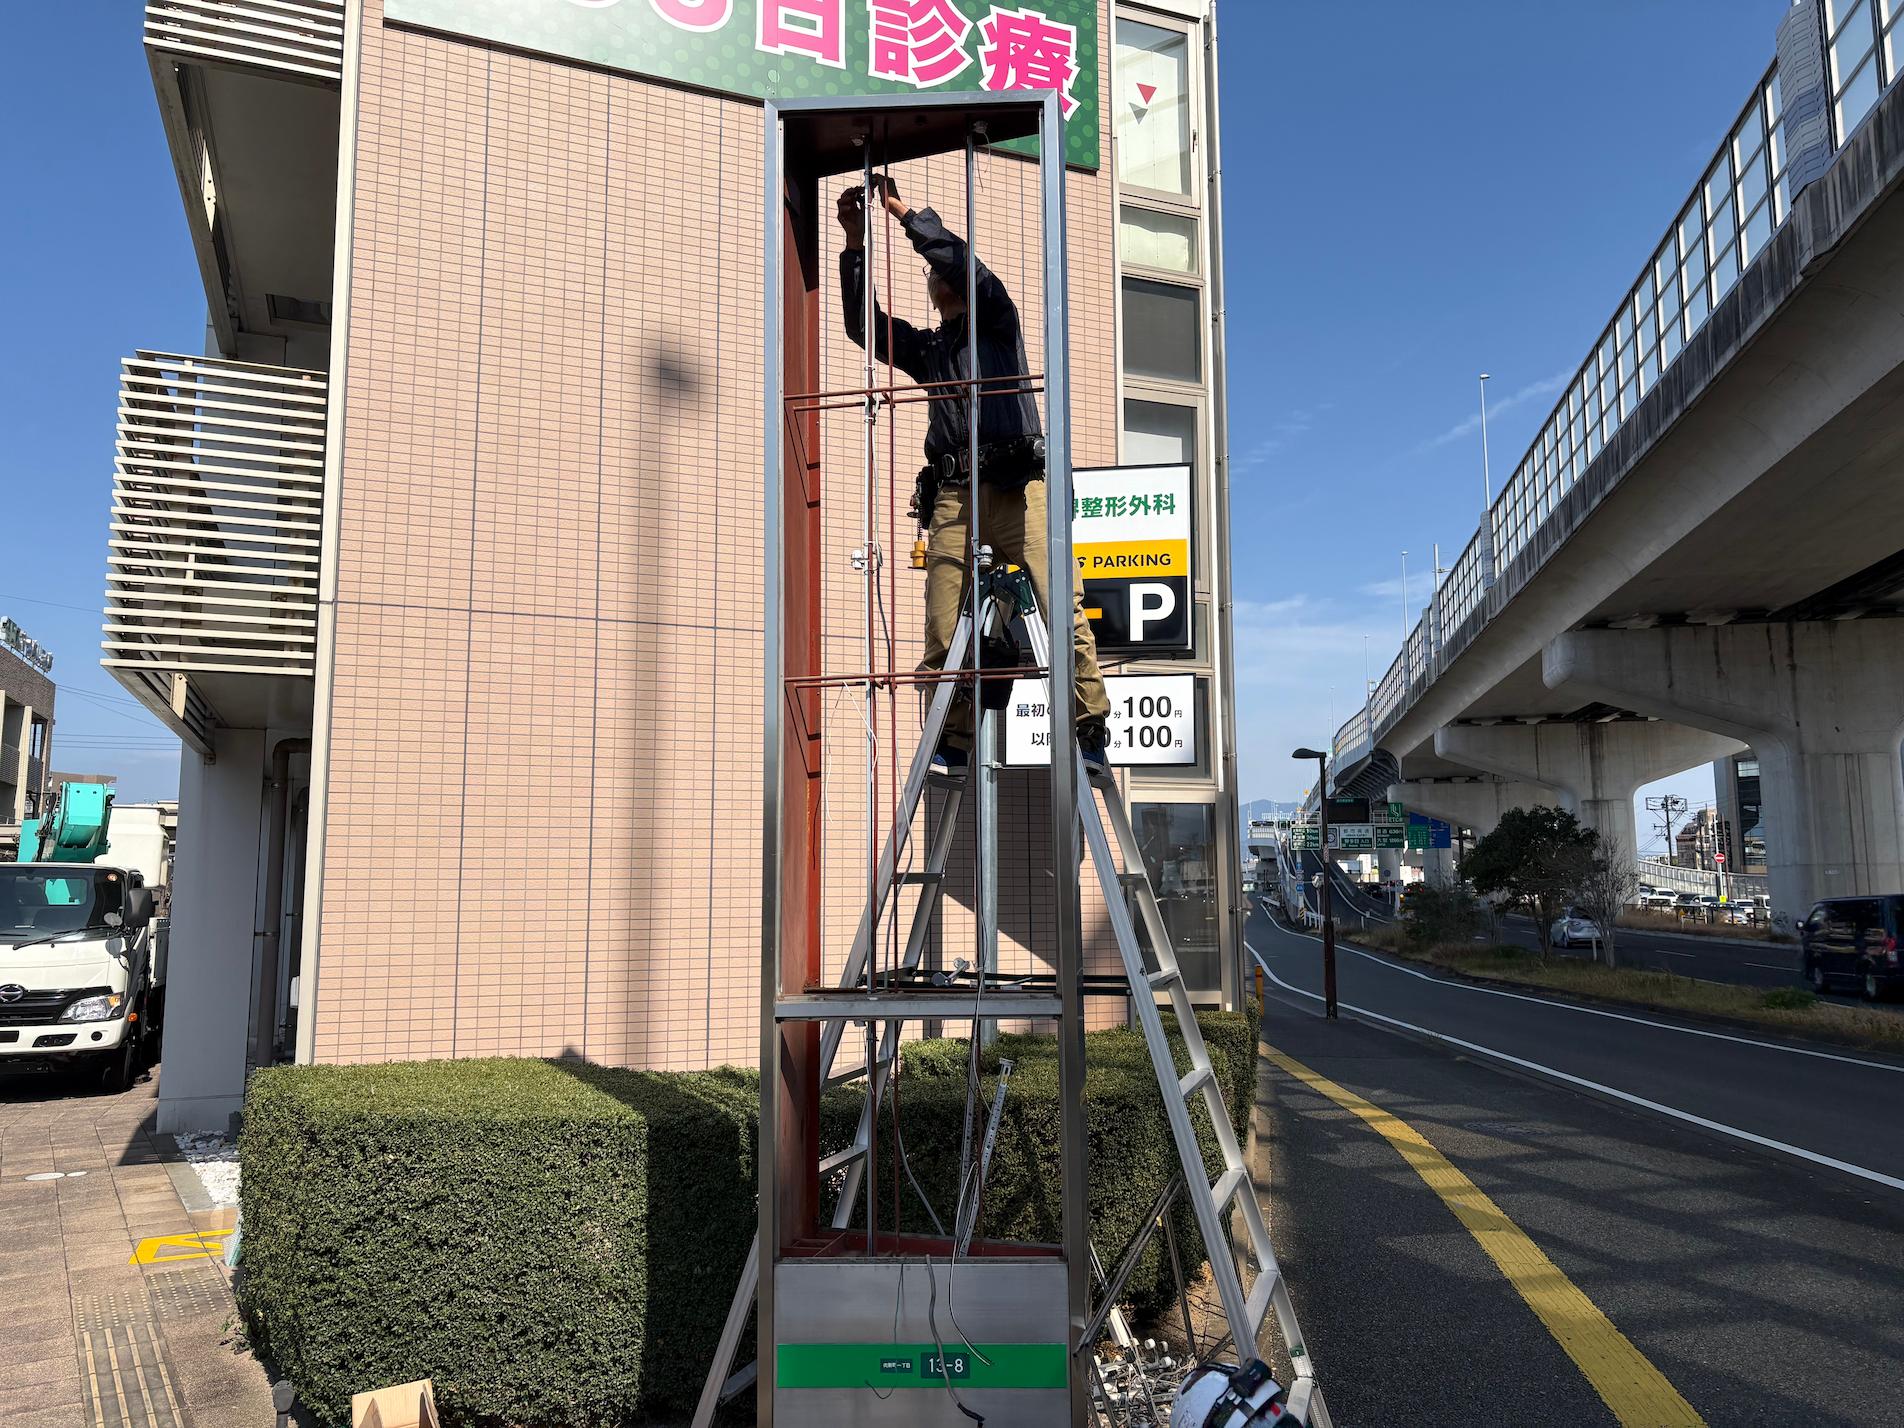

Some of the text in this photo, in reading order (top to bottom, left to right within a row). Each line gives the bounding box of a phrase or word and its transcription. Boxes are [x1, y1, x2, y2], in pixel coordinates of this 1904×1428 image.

[1093, 553, 1172, 568] PARKING
[1129, 582, 1176, 642] P
[1016, 703, 1050, 718] 最初
